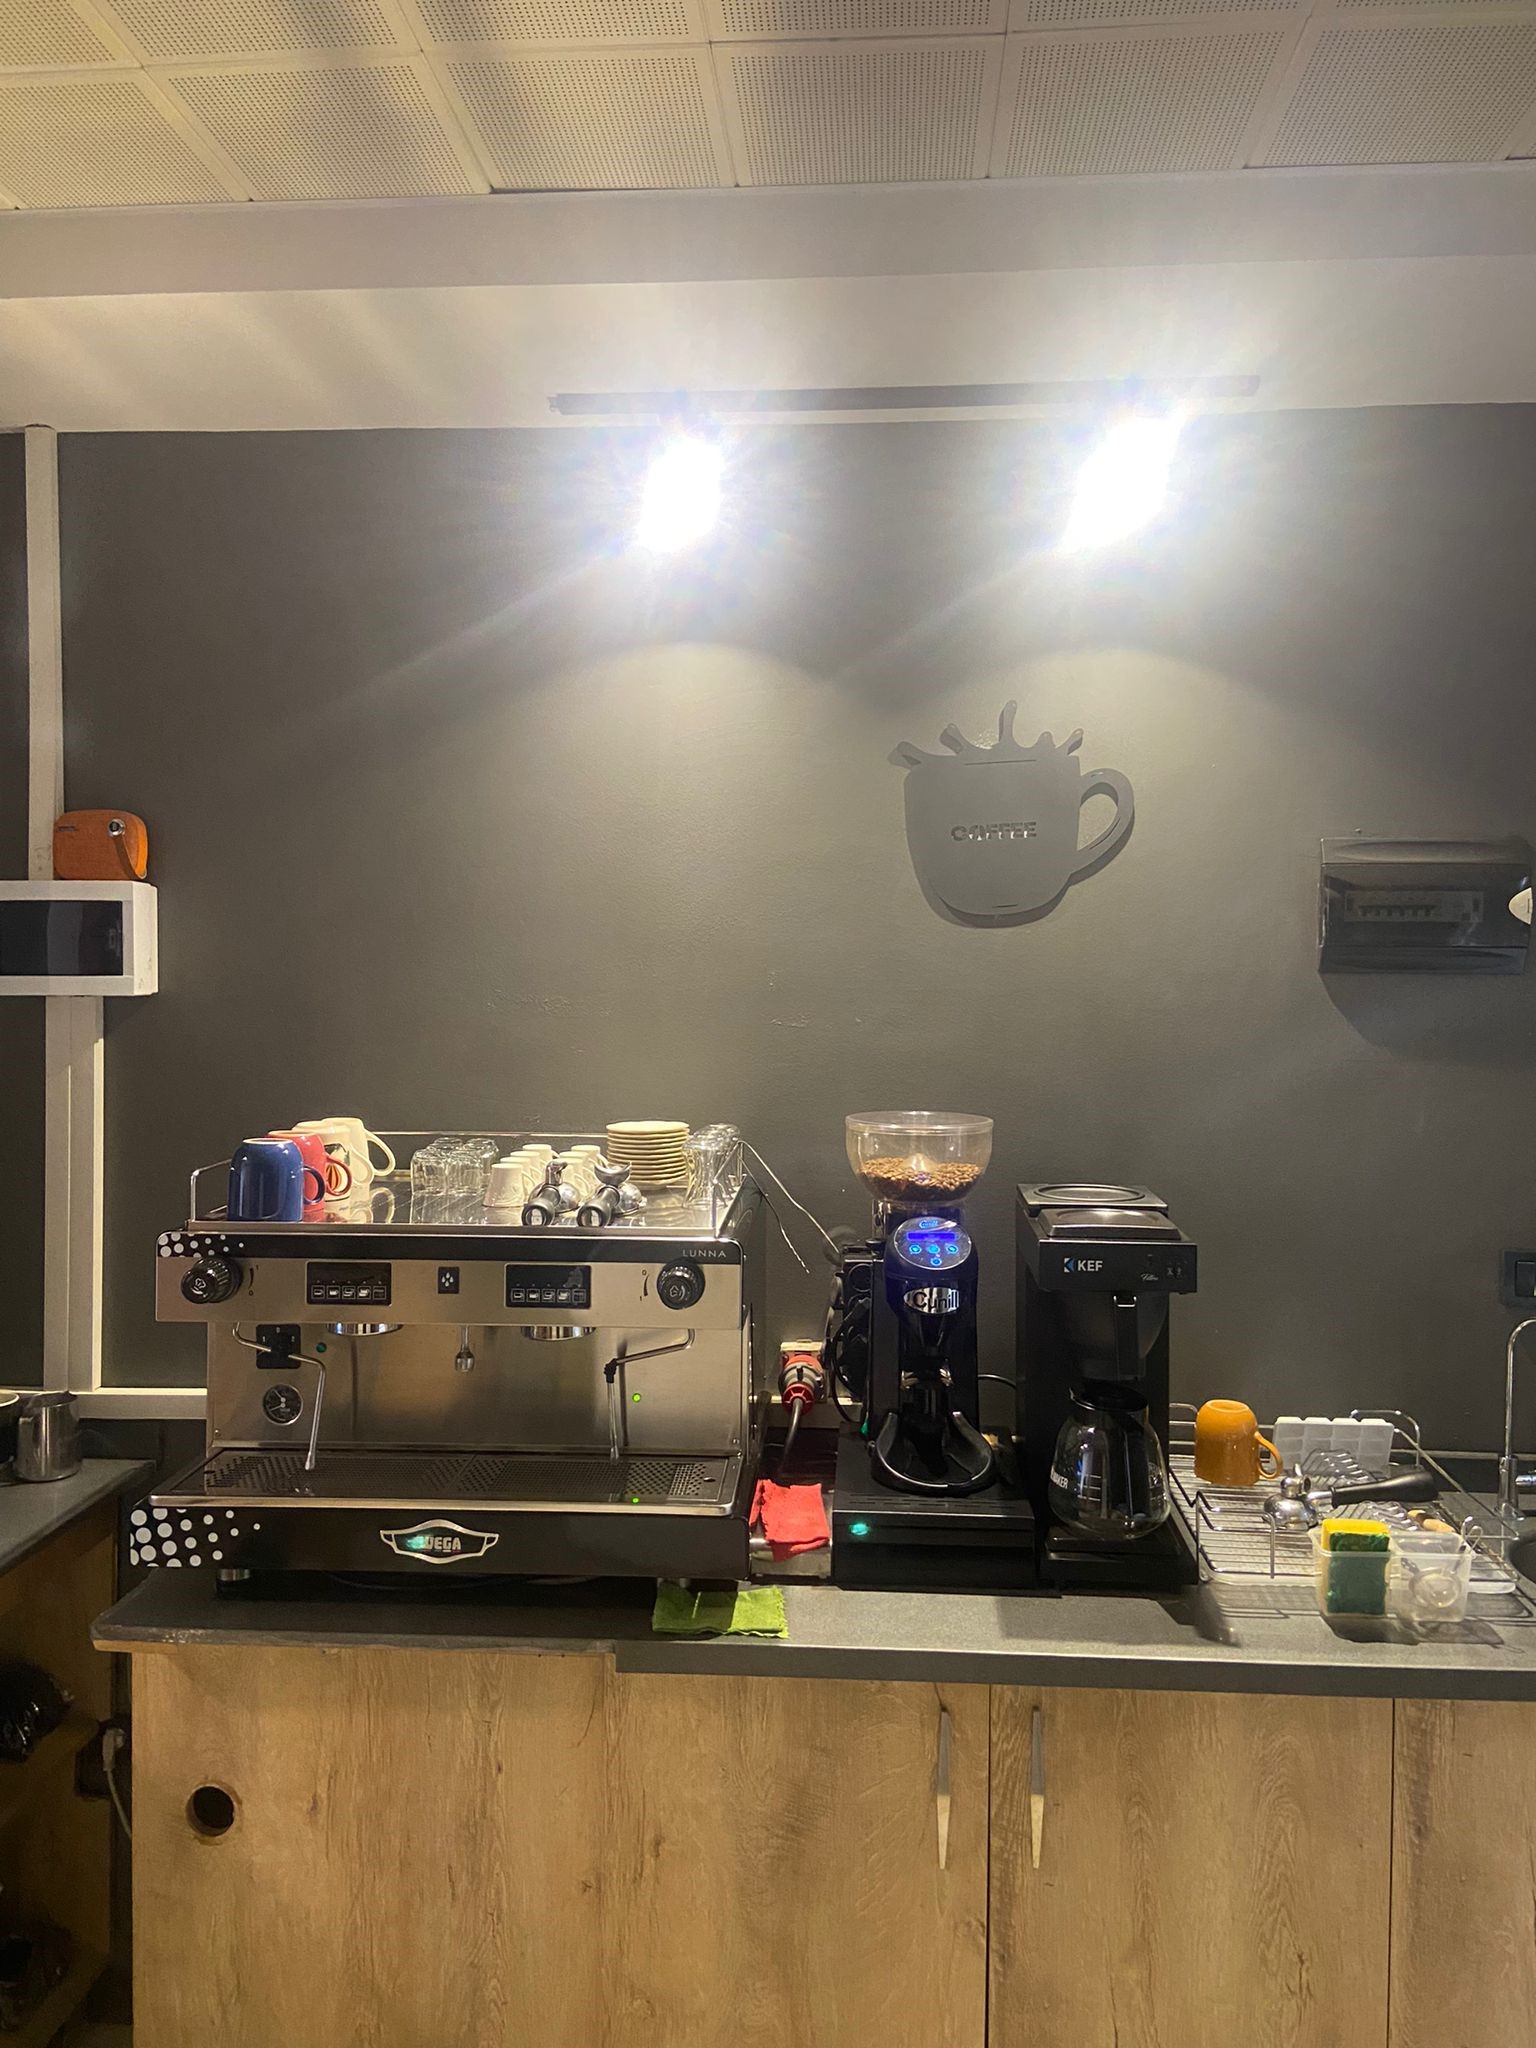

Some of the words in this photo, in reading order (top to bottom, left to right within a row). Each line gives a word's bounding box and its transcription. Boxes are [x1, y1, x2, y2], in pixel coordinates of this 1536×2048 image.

[951, 822, 1036, 841] COFFEE
[682, 1249, 726, 1258] LUNNA
[1078, 1260, 1103, 1272] KEF
